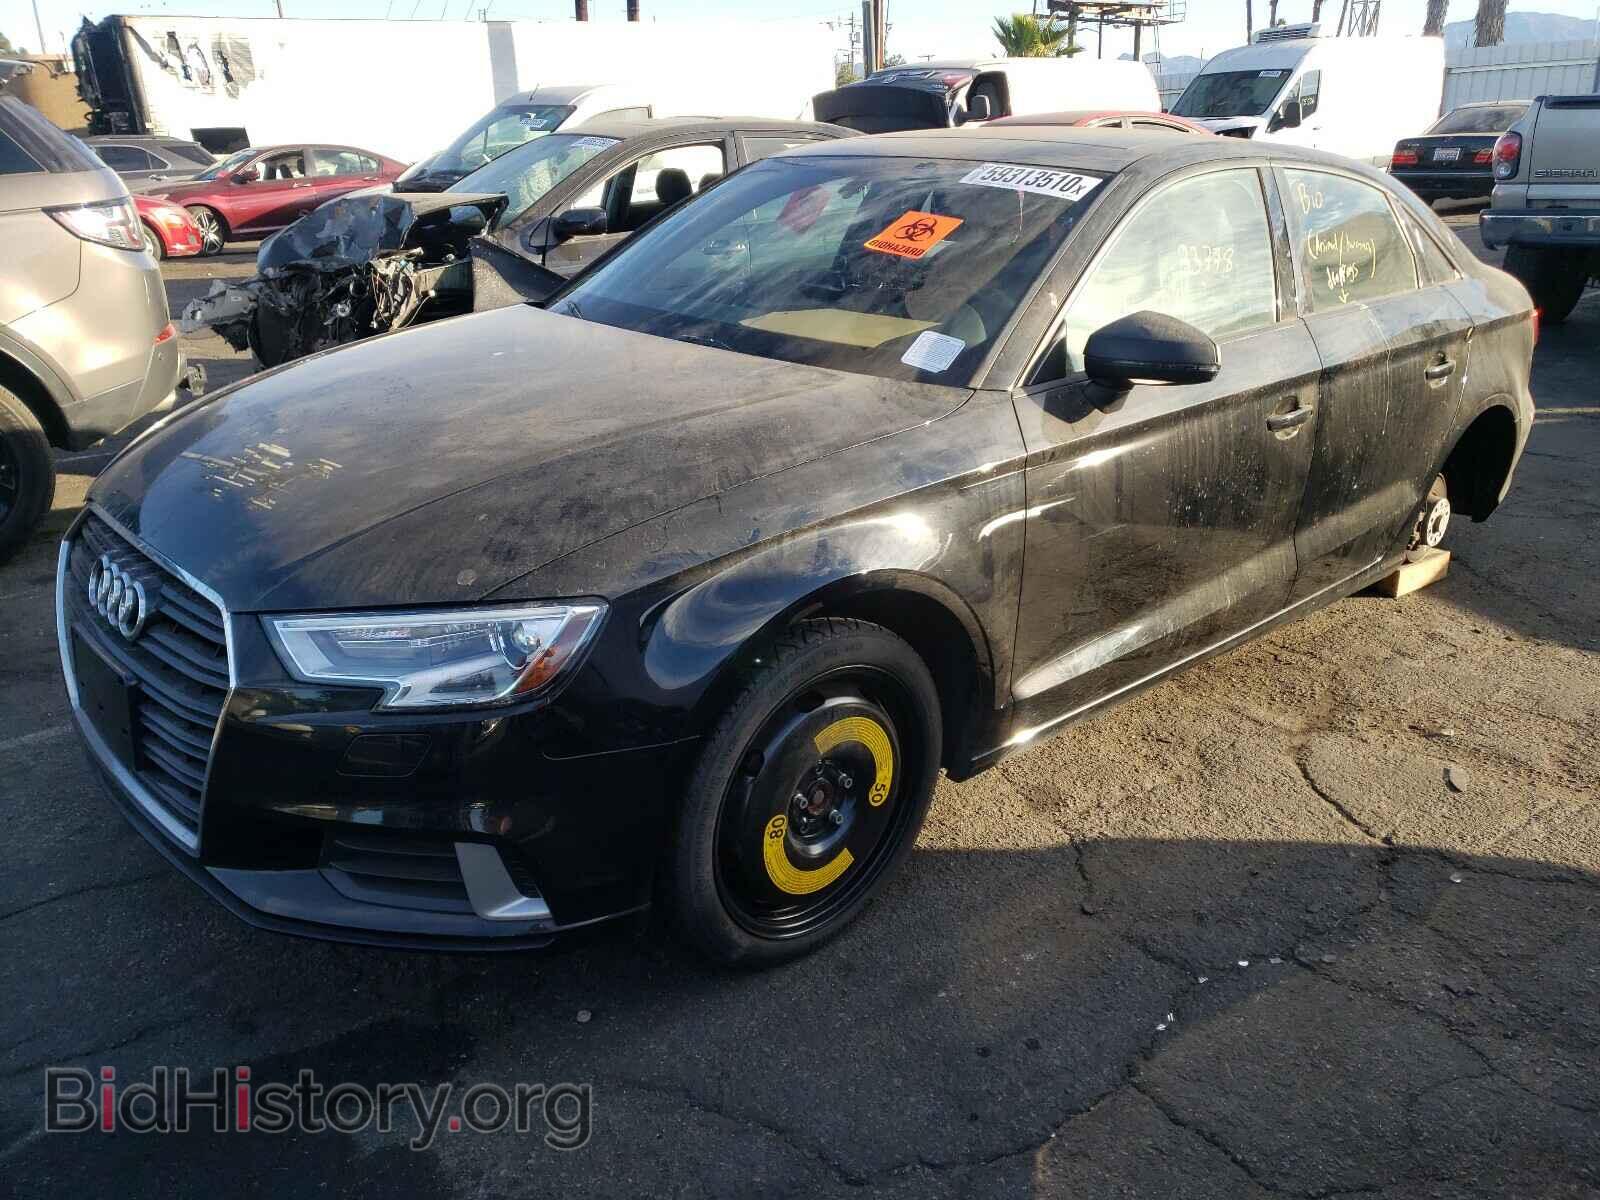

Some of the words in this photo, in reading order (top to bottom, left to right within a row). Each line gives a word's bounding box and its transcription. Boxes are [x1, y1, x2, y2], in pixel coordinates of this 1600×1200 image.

[1534, 168, 1598, 177] SIERRA
[867, 240, 925, 256] BIOHAZARD
[872, 782, 886, 803] 50
[769, 817, 785, 840] 80
